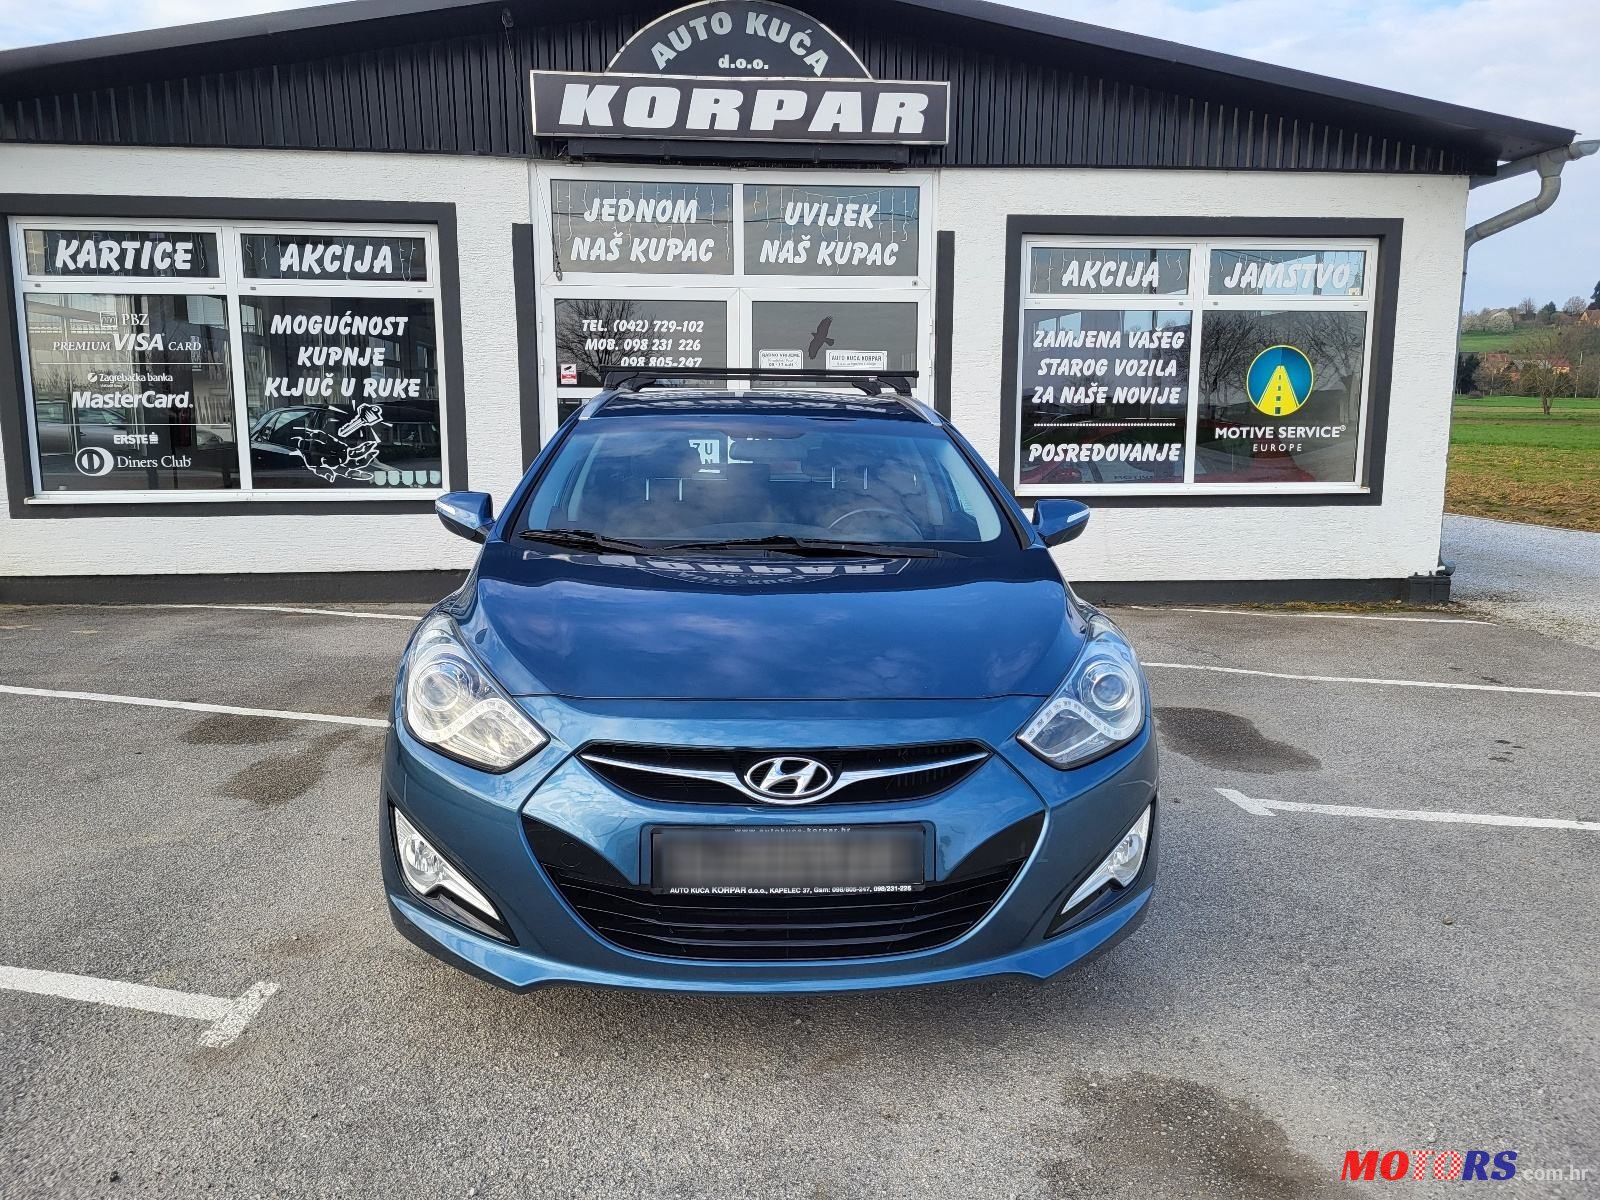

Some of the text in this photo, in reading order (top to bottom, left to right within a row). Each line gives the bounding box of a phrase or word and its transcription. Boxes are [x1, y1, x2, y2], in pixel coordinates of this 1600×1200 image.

[650, 10, 830, 77] AUTO KUĆA
[718, 54, 769, 71] d.o.o.
[558, 82, 929, 134] KORPAR
[583, 198, 698, 225] JEDNOM
[783, 201, 879, 231] UVIJEK
[55, 239, 193, 271] KARTICE
[570, 231, 716, 264] NAŠ KUPAC
[759, 235, 899, 267] NAŠ KUPAC
[281, 243, 393, 274] AKCIJA
[1061, 260, 1160, 289] AKCIJA
[1223, 262, 1351, 290] JAMSTVO
[121, 313, 149, 326] PBZ
[270, 310, 409, 337] MOGUĆNOST
[582, 319, 705, 333] TEL. (042) 729-102
[53, 333, 202, 351] PREMIUM VISA CARD
[585, 338, 701, 351] MOB. 098 231 226
[1033, 327, 1186, 350] ZAMJENA VAŠEG
[297, 347, 386, 368] KUPNJE
[620, 356, 703, 368] 098 805-247
[1037, 358, 1178, 378] STAROG VOZILA
[100, 372, 173, 384] Zagrebačka banka
[264, 372, 421, 399] KLJUČ U RUKE
[1031, 381, 1182, 405] ZA NAŠE NOVIJE
[113, 434, 148, 445] ERSTE
[1215, 427, 1274, 439] MOTIVE
[1028, 443, 1182, 463] POSREDOVANJE
[1252, 443, 1303, 452] EUROPE
[117, 454, 192, 468] Diners Club
[711, 886, 747, 894] KORPAR
